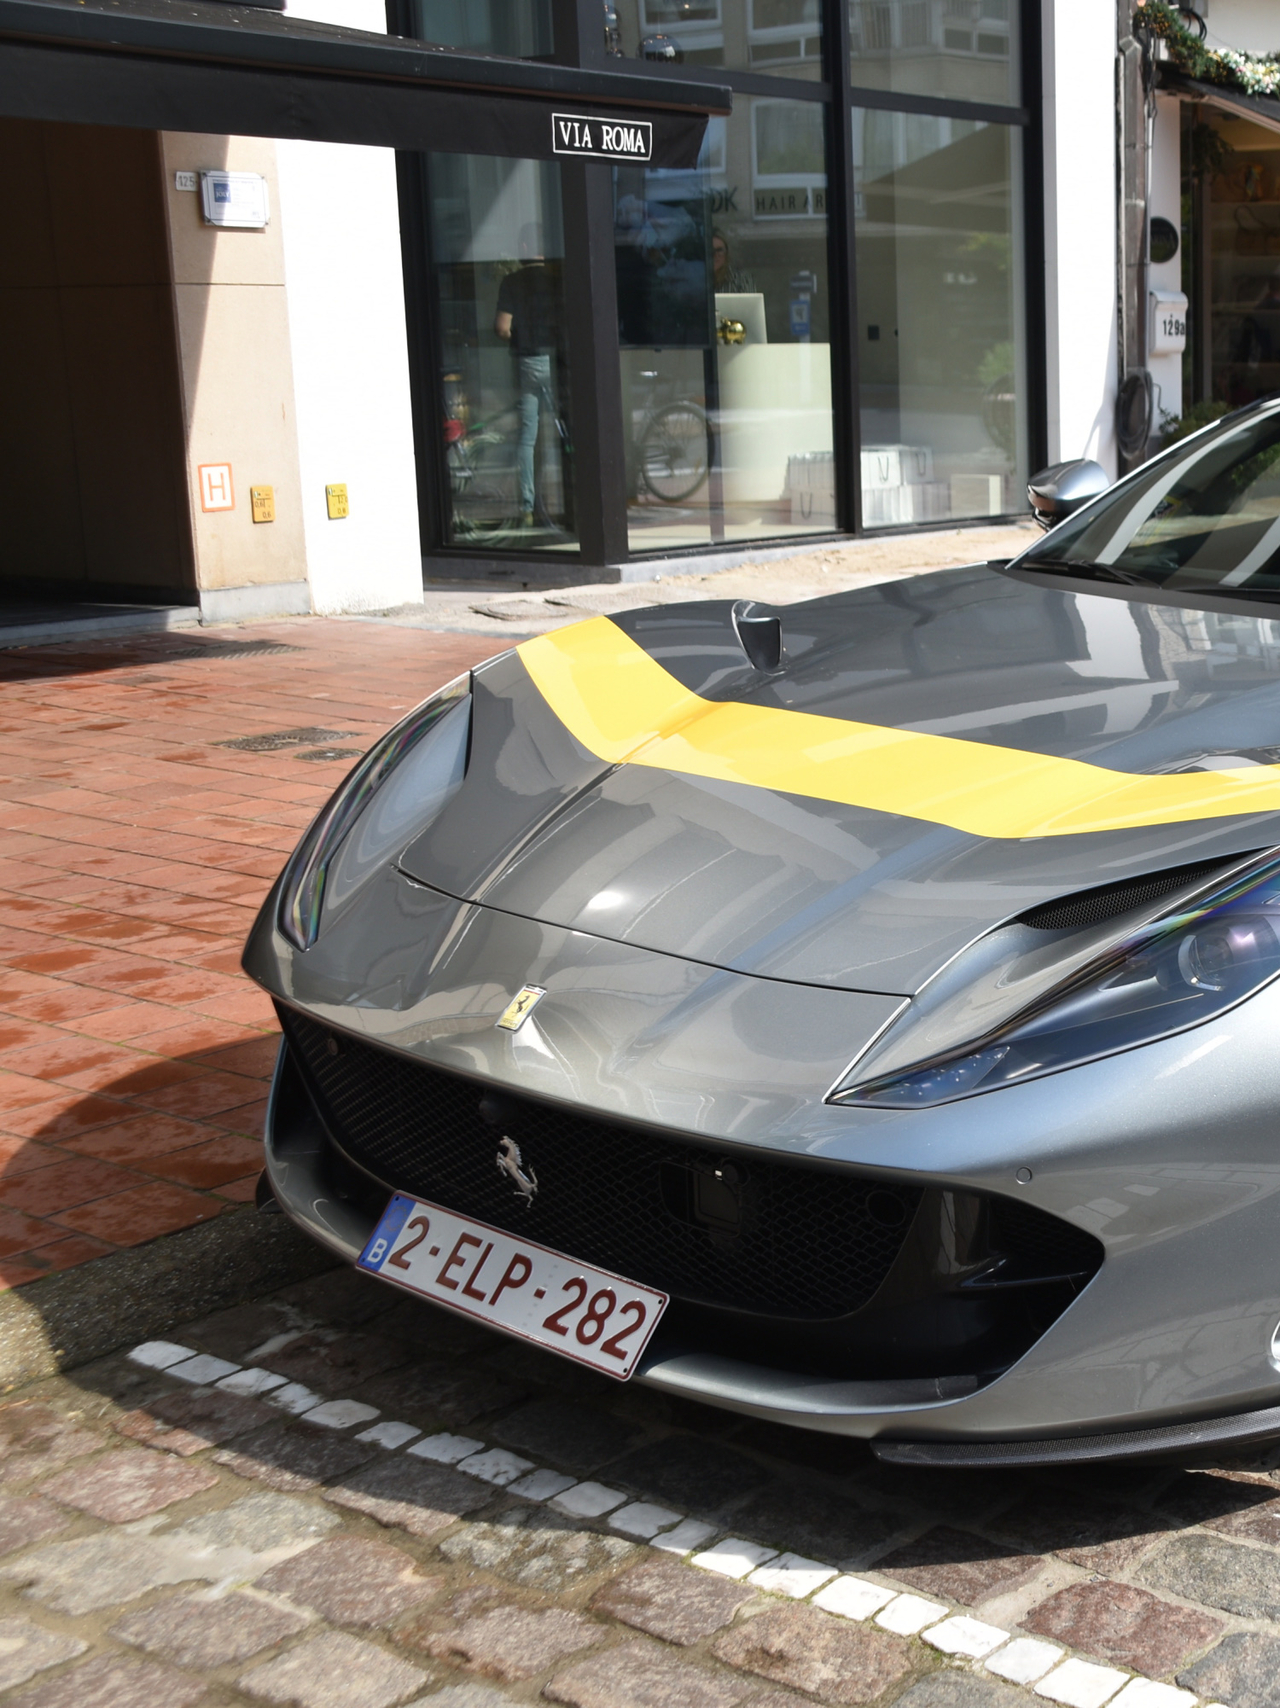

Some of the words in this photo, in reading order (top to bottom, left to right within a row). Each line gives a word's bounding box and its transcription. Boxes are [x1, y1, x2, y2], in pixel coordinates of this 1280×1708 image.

[559, 121, 593, 148] VIA
[601, 125, 646, 153] ROMA
[178, 175, 195, 187] 125
[756, 194, 796, 211] HAIR
[1162, 319, 1186, 336] 129a
[207, 472, 226, 501] H
[367, 1238, 388, 1264] B
[388, 1215, 647, 1361] 2-ELP-282
